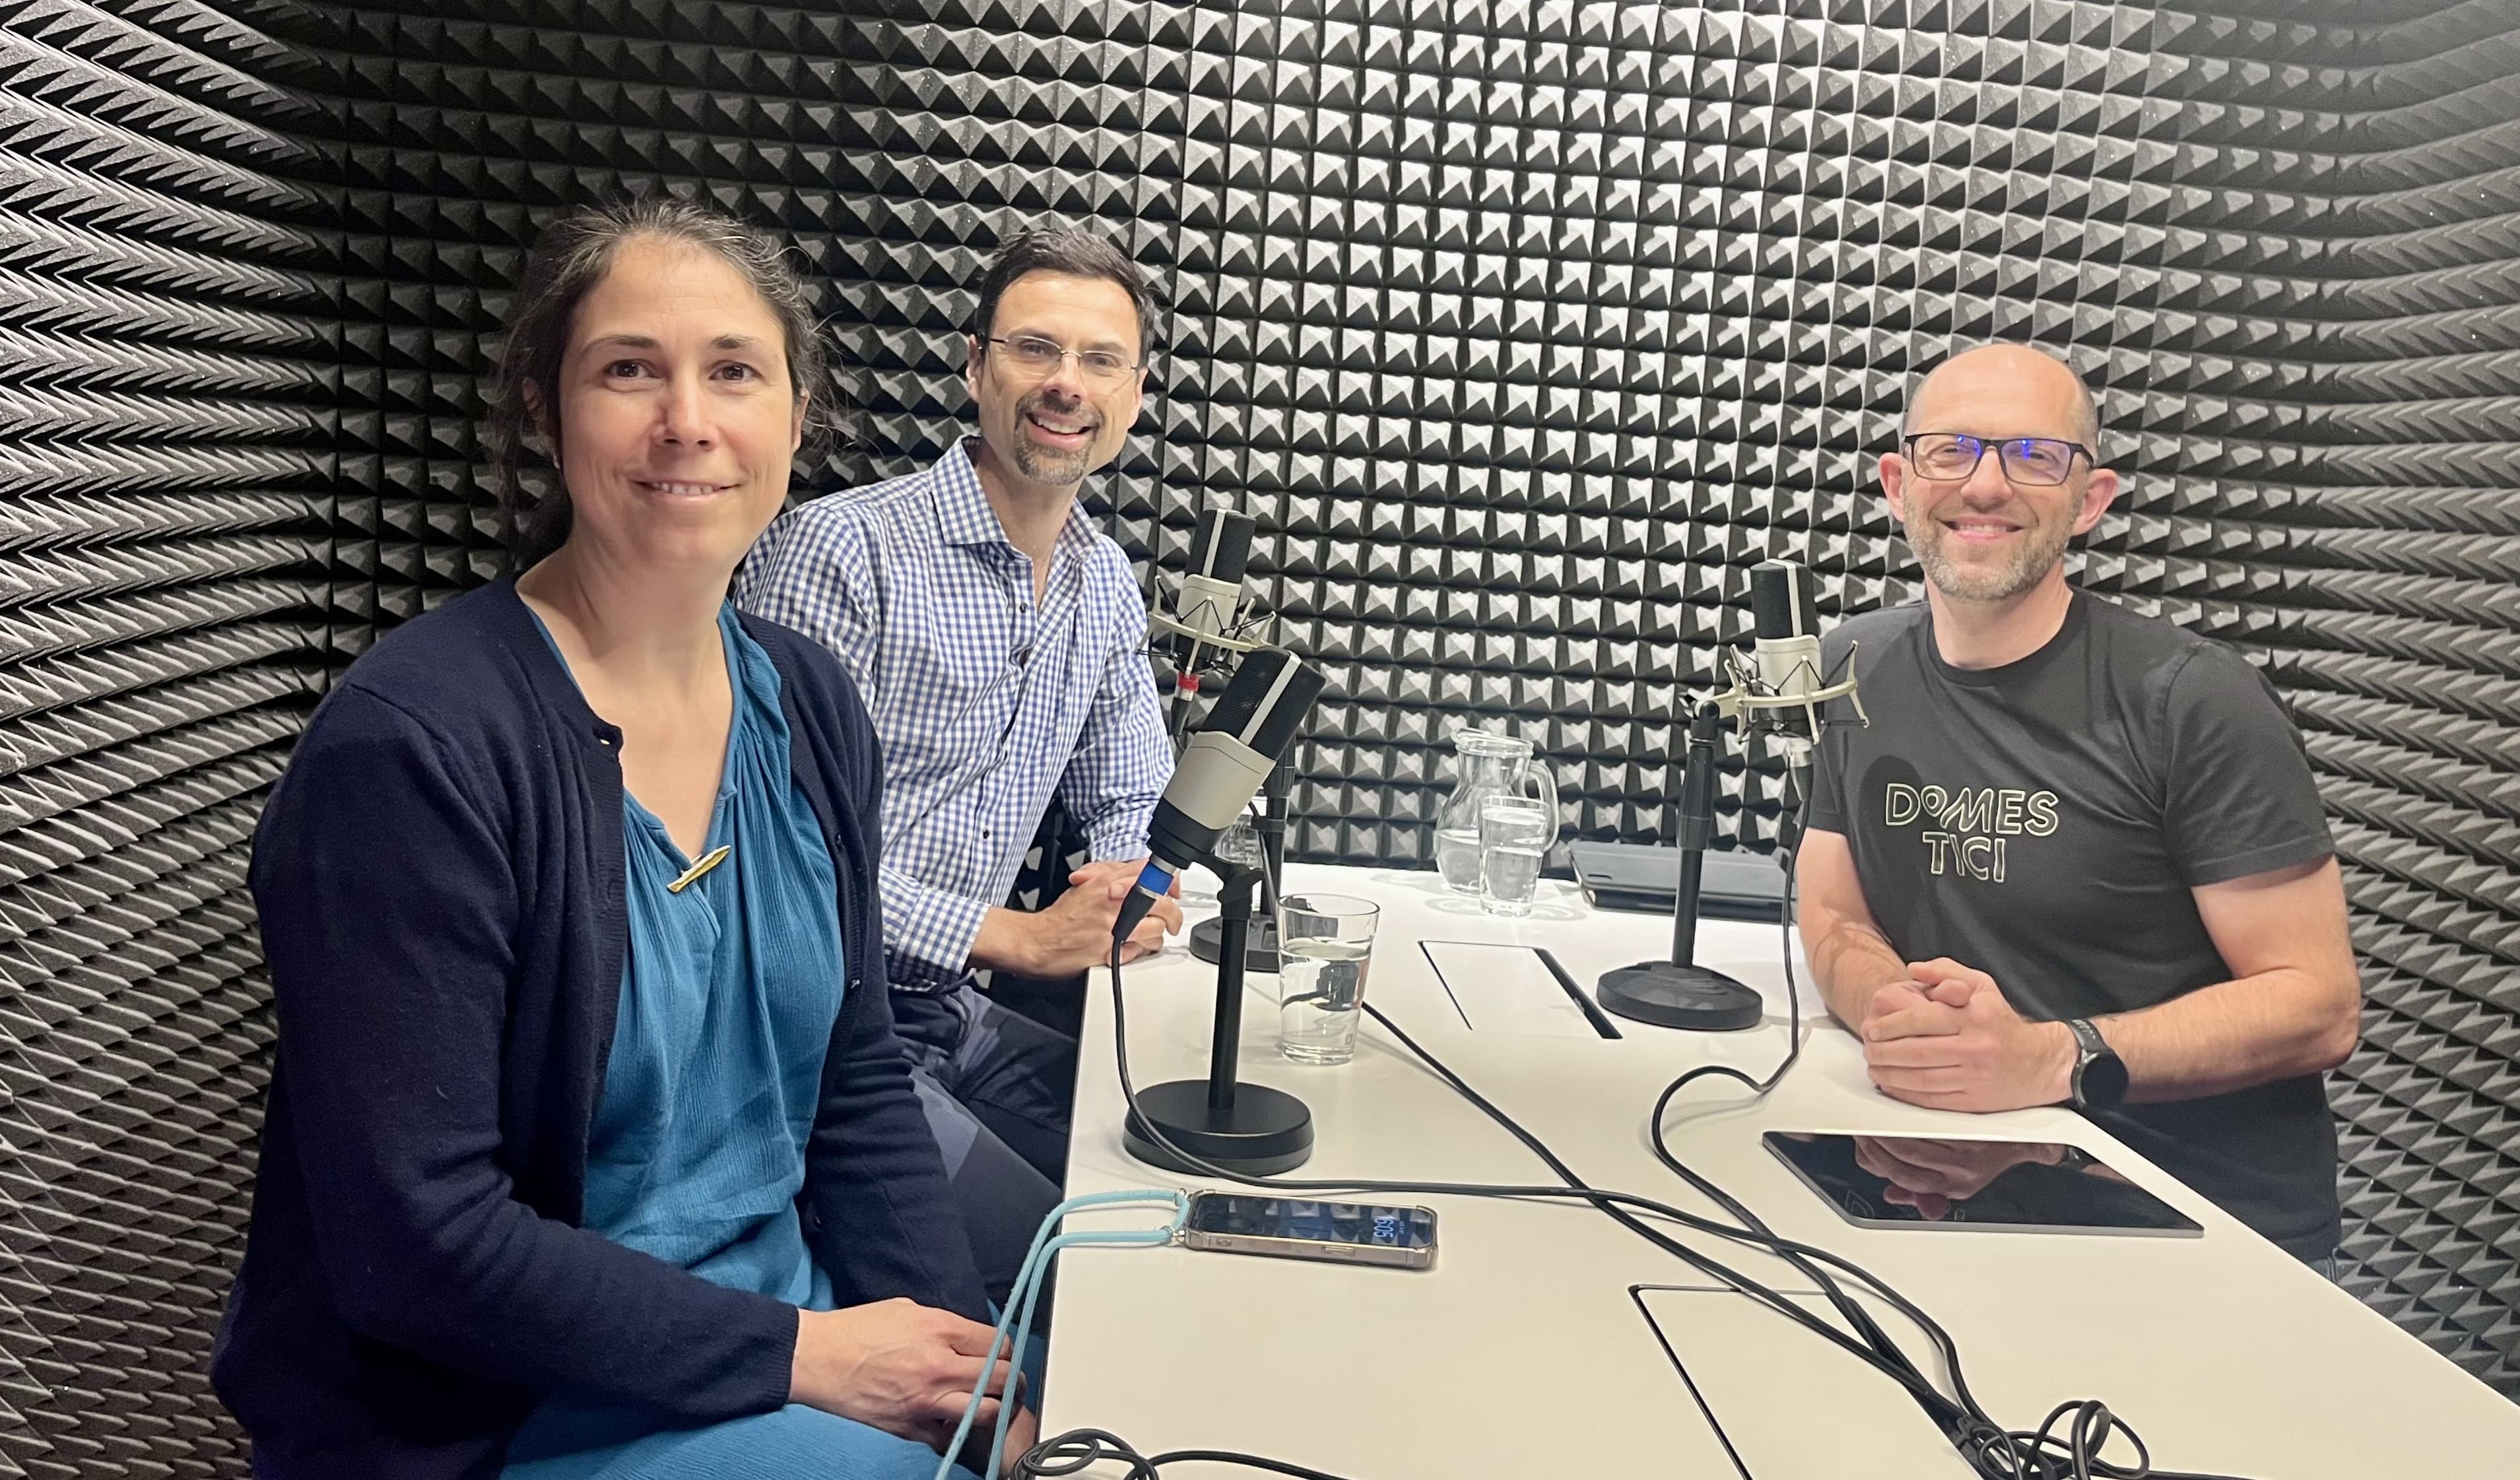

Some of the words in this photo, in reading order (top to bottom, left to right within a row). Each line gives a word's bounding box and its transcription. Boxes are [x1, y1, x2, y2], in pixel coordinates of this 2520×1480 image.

[1886, 783, 2059, 836] DOMES
[1923, 831, 2005, 882] TICI
[1373, 1215, 1394, 1238] 16:05
